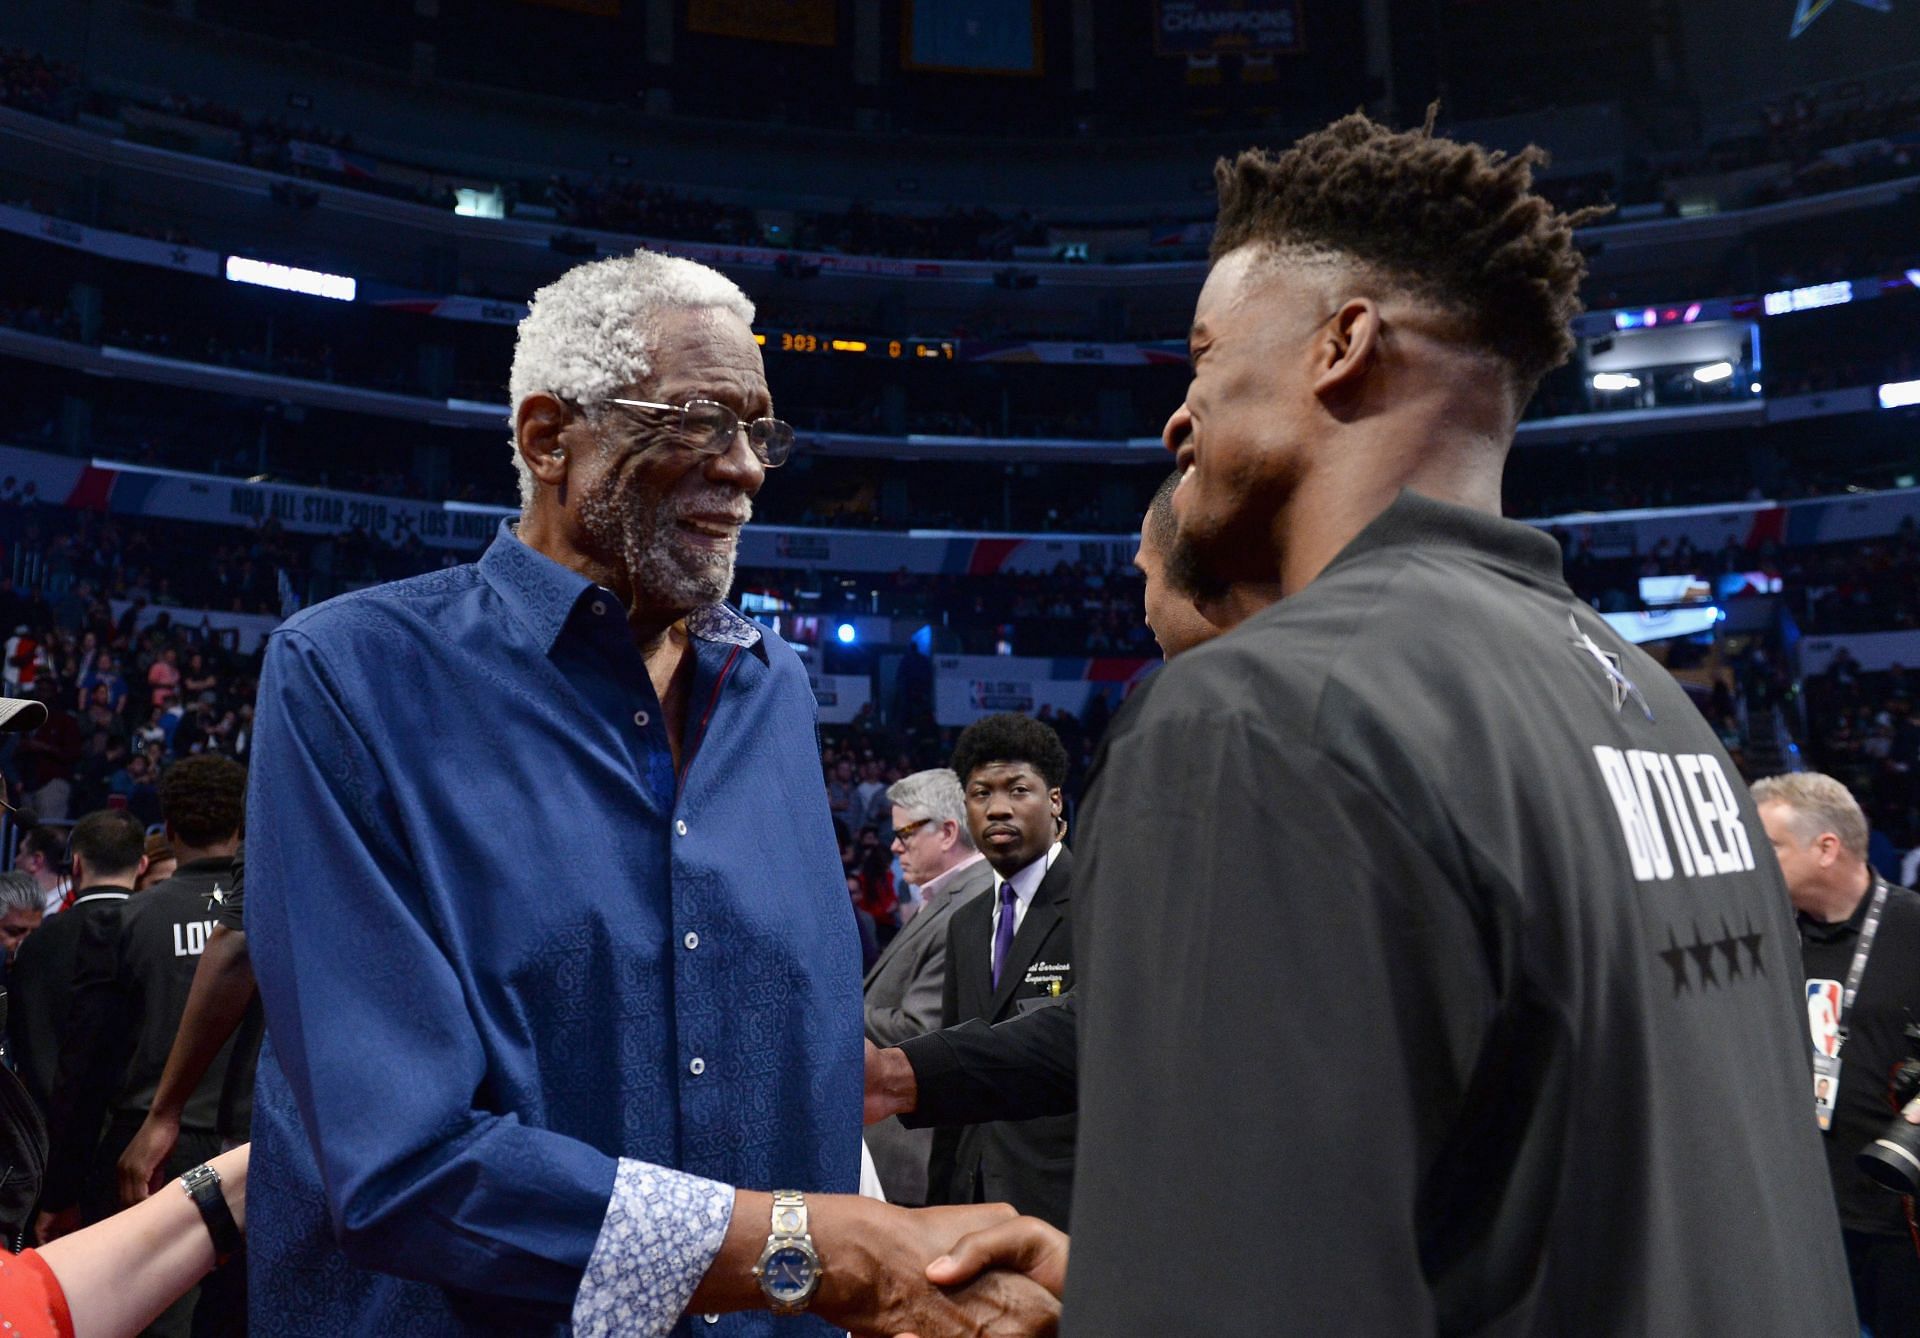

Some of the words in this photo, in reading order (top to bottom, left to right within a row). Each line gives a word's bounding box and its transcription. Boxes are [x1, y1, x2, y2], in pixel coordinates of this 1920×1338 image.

[1162, 9, 1294, 31] CHAMPIONS
[231, 487, 264, 516] NBA
[271, 492, 296, 520] ALL
[303, 496, 343, 525] STAR
[350, 502, 387, 532] 2018
[420, 510, 447, 537] LOS
[1592, 745, 1756, 881] BUTLER
